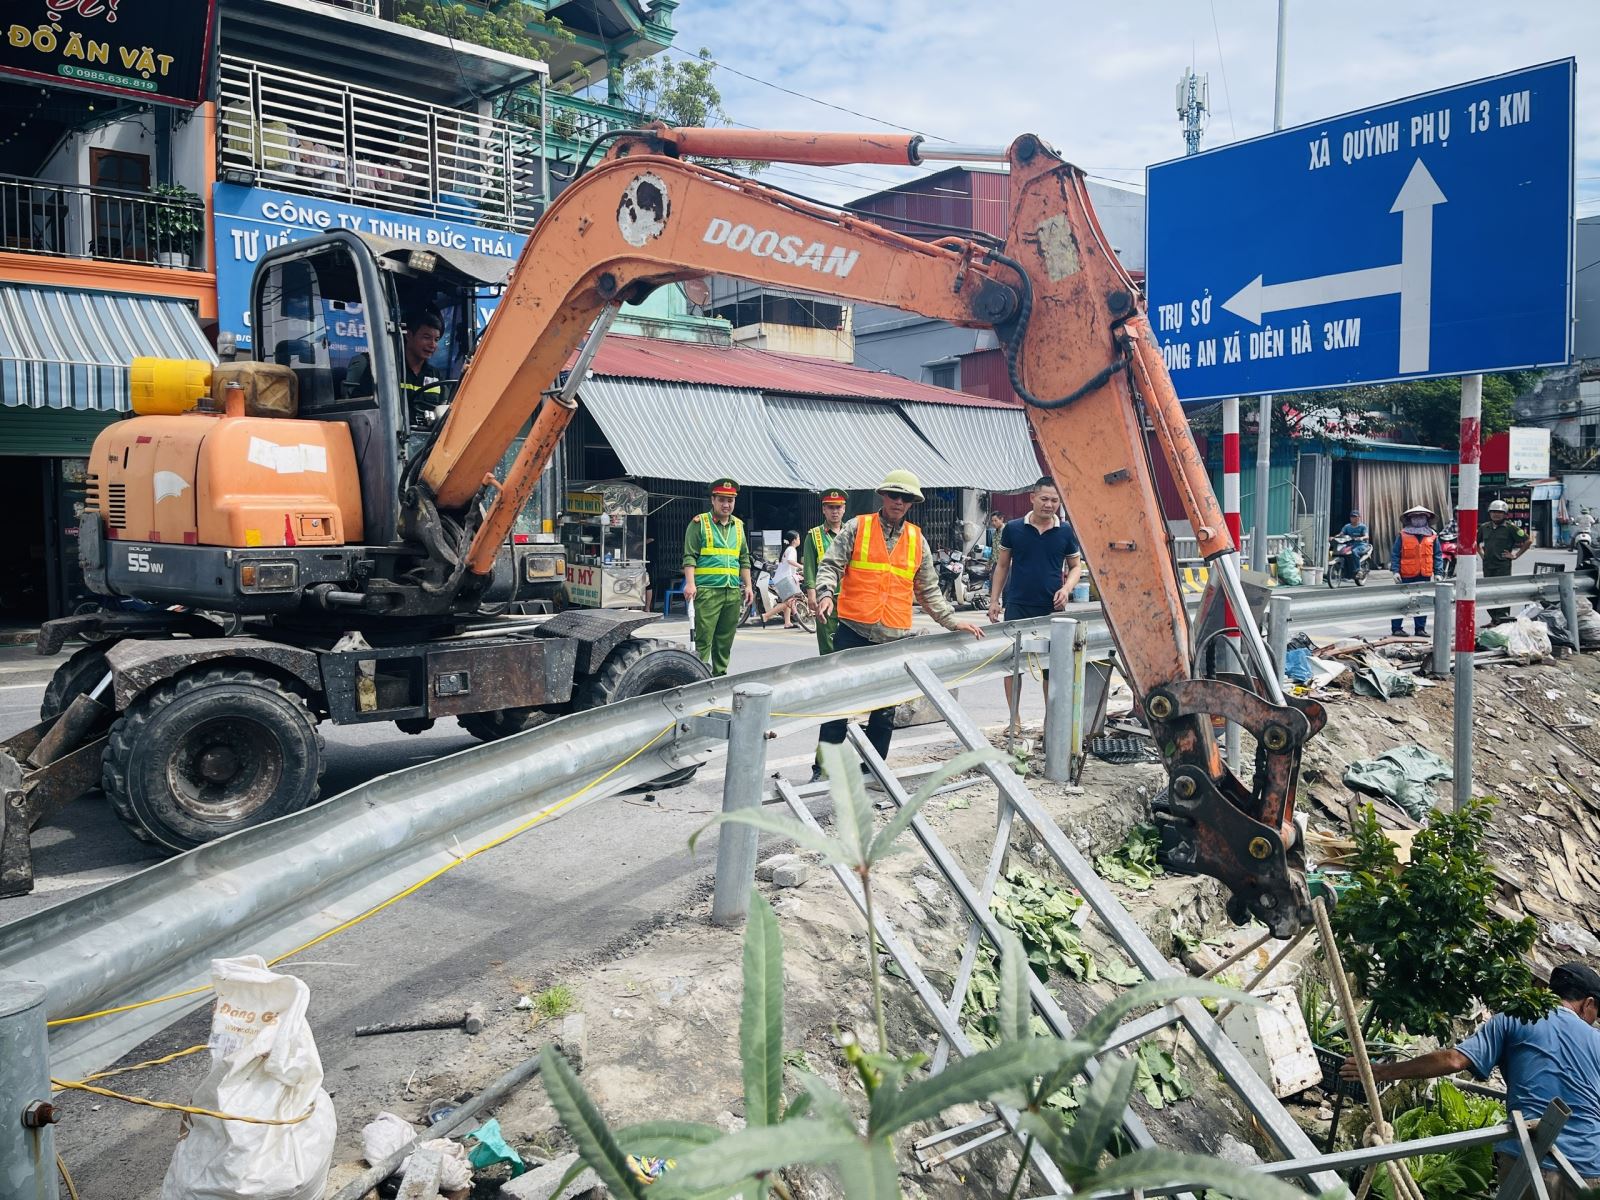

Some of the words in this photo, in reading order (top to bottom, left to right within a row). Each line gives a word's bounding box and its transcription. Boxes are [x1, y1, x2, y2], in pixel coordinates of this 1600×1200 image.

[8, 23, 62, 52] ĐỒ
[63, 32, 109, 64] ĂN
[119, 47, 174, 79] VẶT
[77, 69, 154, 89] 0985.636.819
[1309, 131, 1331, 170] XÃ
[1342, 120, 1399, 165] QUỲNH
[1411, 109, 1450, 148] PHỤ
[1468, 100, 1490, 134] 13
[1500, 90, 1530, 128] KM
[231, 229, 259, 262] TƯ
[262, 200, 331, 228] CÔNG
[338, 214, 362, 231] TY
[369, 219, 421, 243] TNHH
[426, 226, 466, 250] ĐỨC
[472, 237, 512, 258] THÁI
[703, 217, 861, 278] DOOSAN
[1158, 302, 1183, 333] TRỤ
[1191, 288, 1212, 326] SỞ
[1197, 338, 1216, 367] AN
[1223, 330, 1241, 364] XÃ
[1250, 325, 1284, 360] DIÊN
[1291, 320, 1312, 355] HÀ
